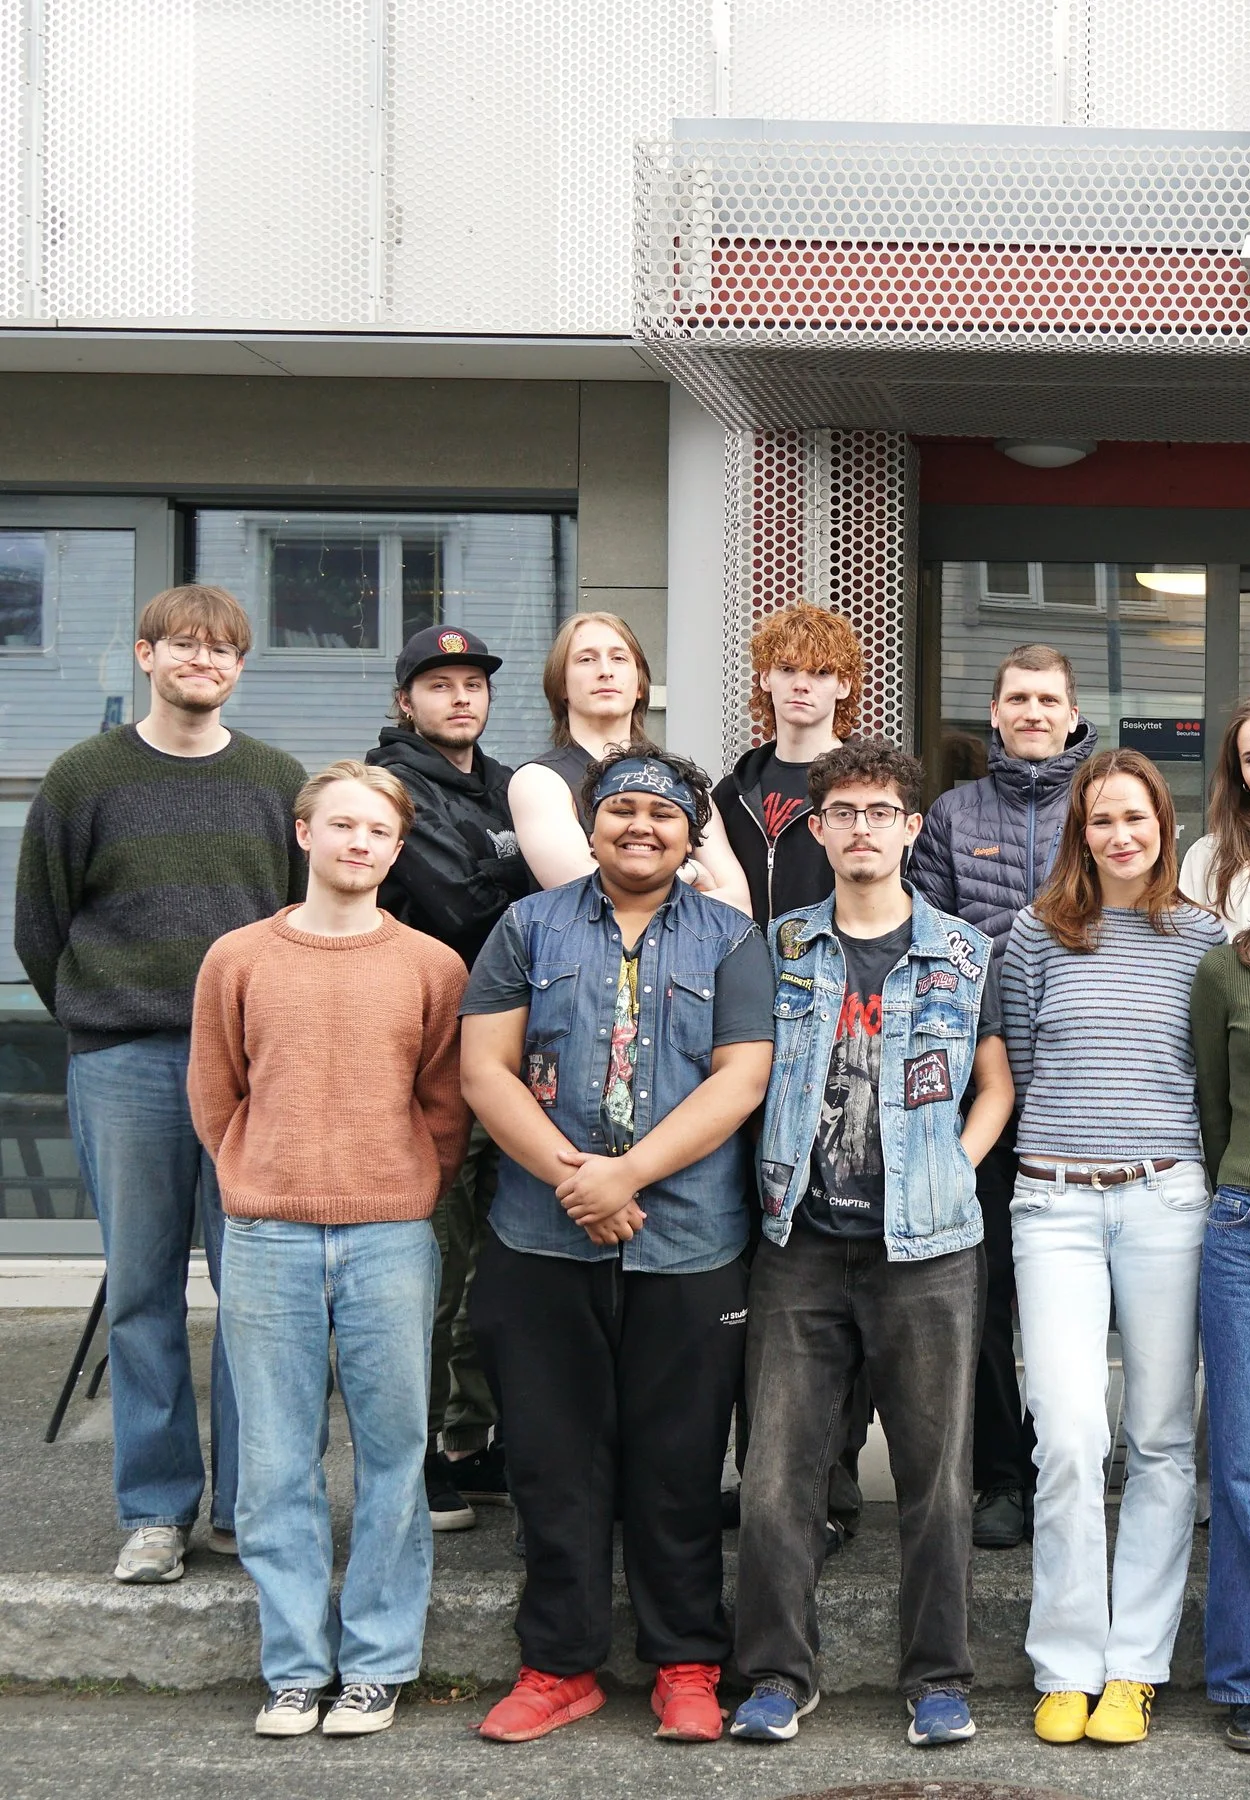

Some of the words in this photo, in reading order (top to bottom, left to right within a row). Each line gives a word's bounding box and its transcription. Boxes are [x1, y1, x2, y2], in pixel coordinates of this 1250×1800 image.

[1122, 721, 1162, 730] Beskyttet
[829, 1197, 871, 1209] CHAPTER
[720, 1313, 729, 1321] JJ
